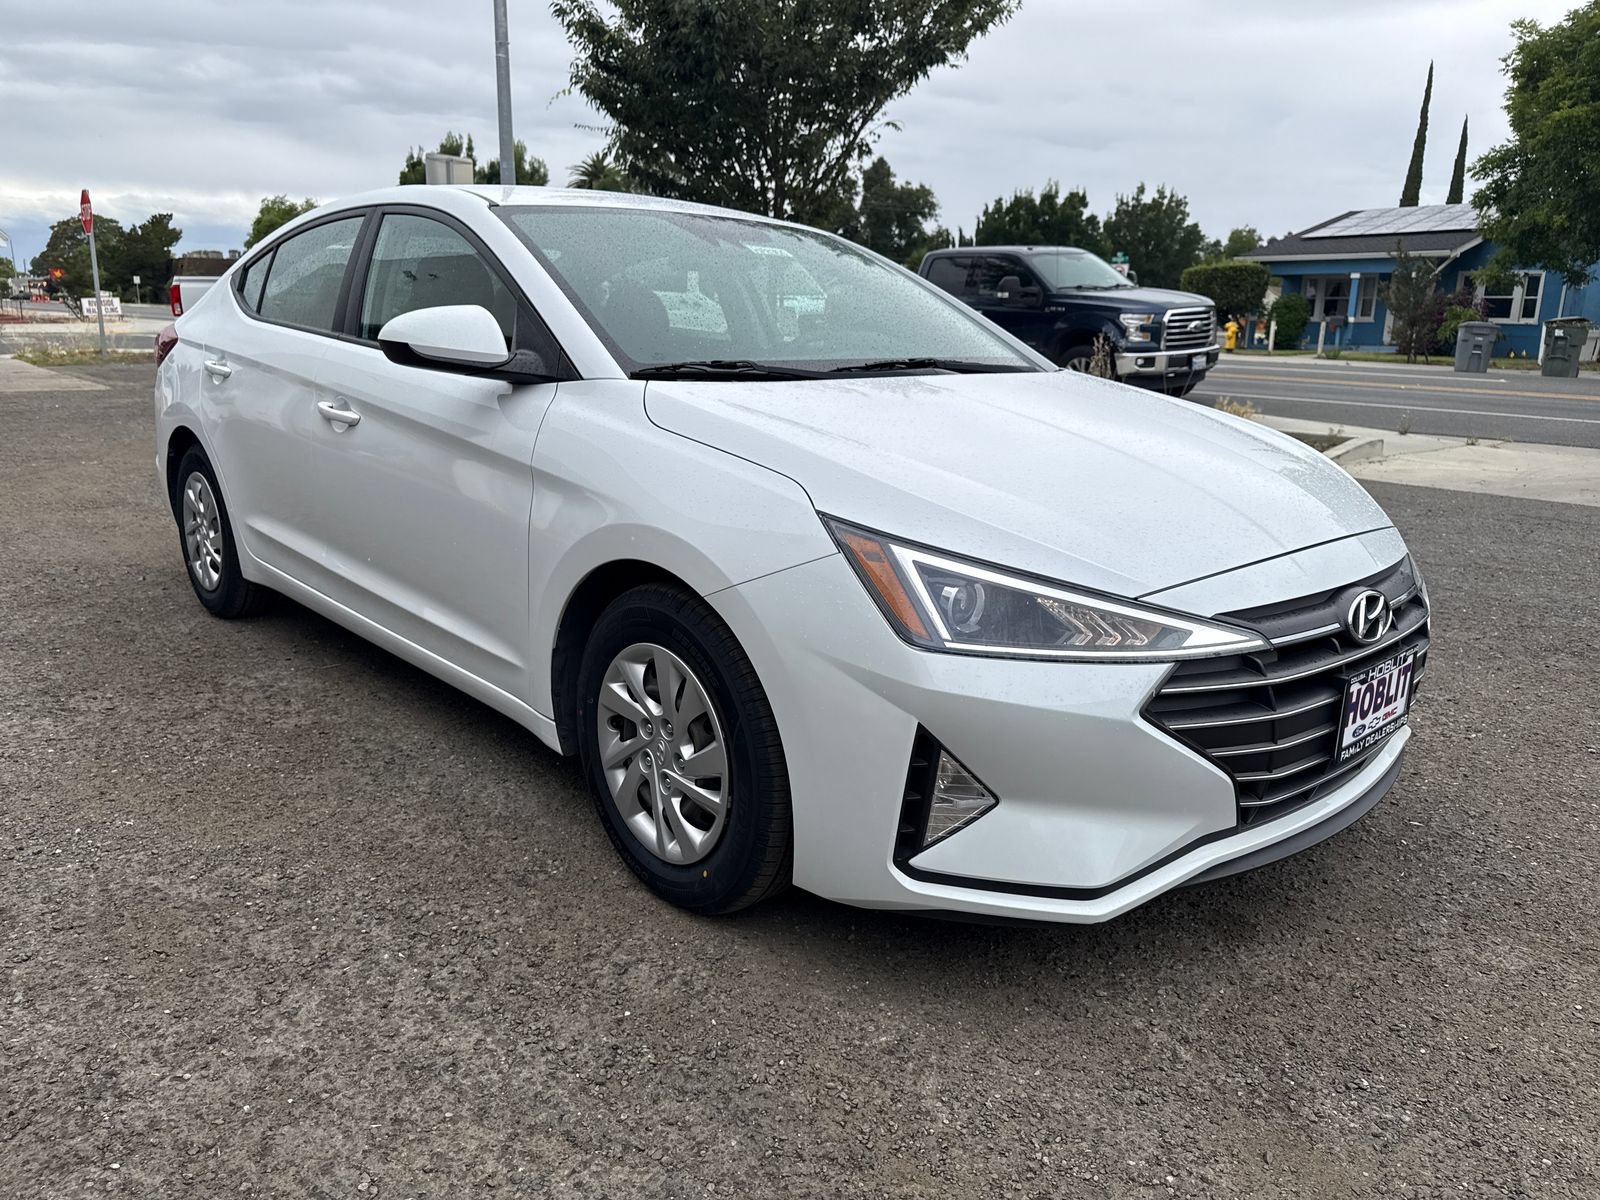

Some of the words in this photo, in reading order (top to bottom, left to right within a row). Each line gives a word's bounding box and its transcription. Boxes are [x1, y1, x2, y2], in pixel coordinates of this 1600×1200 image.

[1368, 652, 1407, 682] HOBLIT
[1346, 662, 1413, 728] HOBLIT
[1382, 706, 1398, 721] GMC
